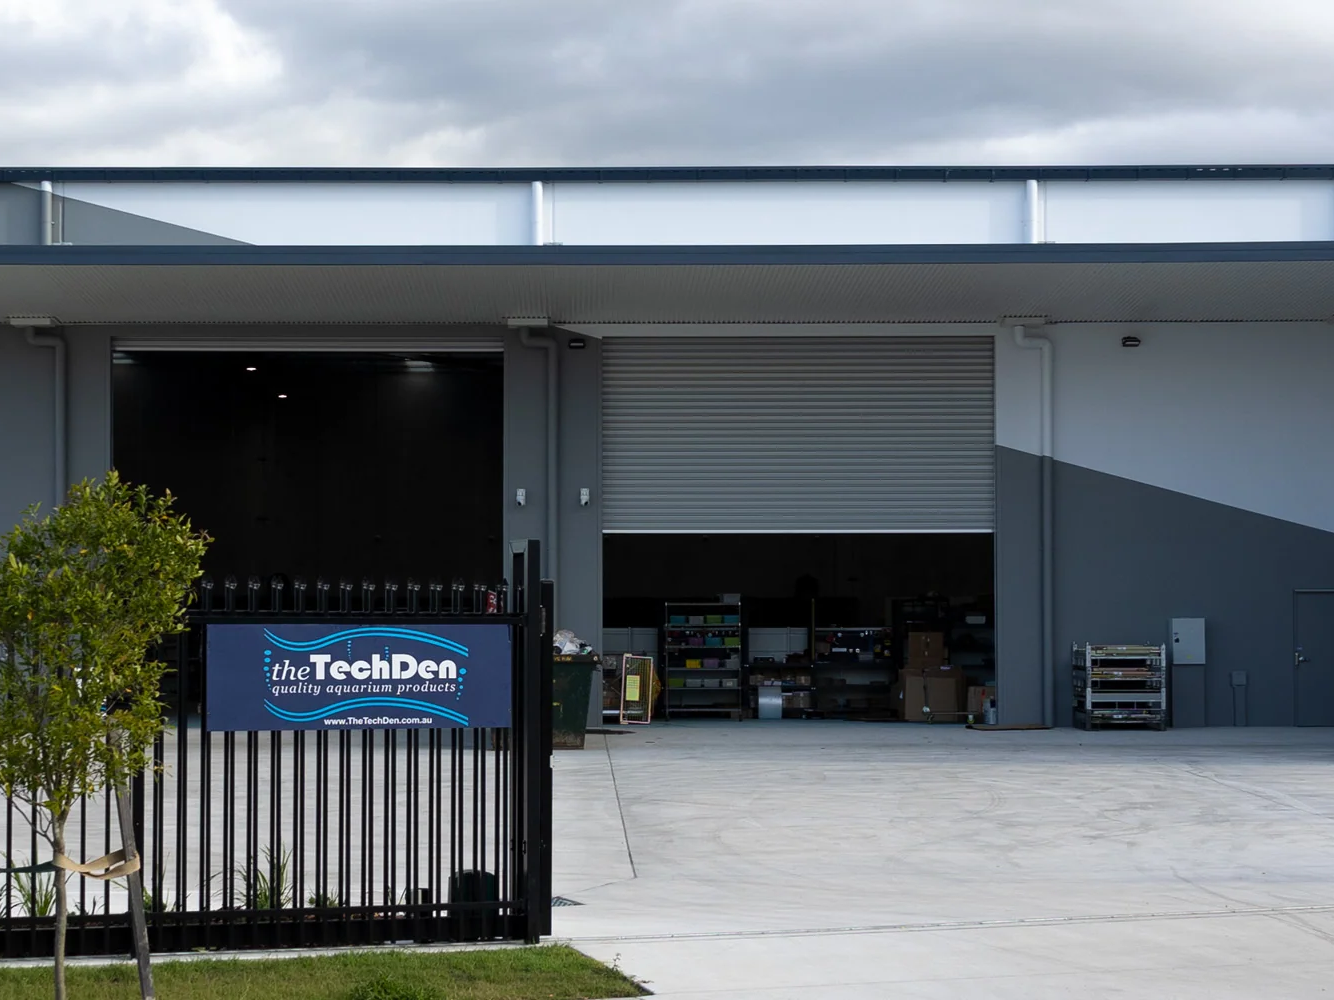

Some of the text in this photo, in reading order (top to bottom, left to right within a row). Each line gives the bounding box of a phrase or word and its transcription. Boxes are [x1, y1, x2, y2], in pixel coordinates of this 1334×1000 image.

[271, 682, 456, 696] quality aquarium products
[324, 717, 433, 726] www.TheTechDen.com.au
